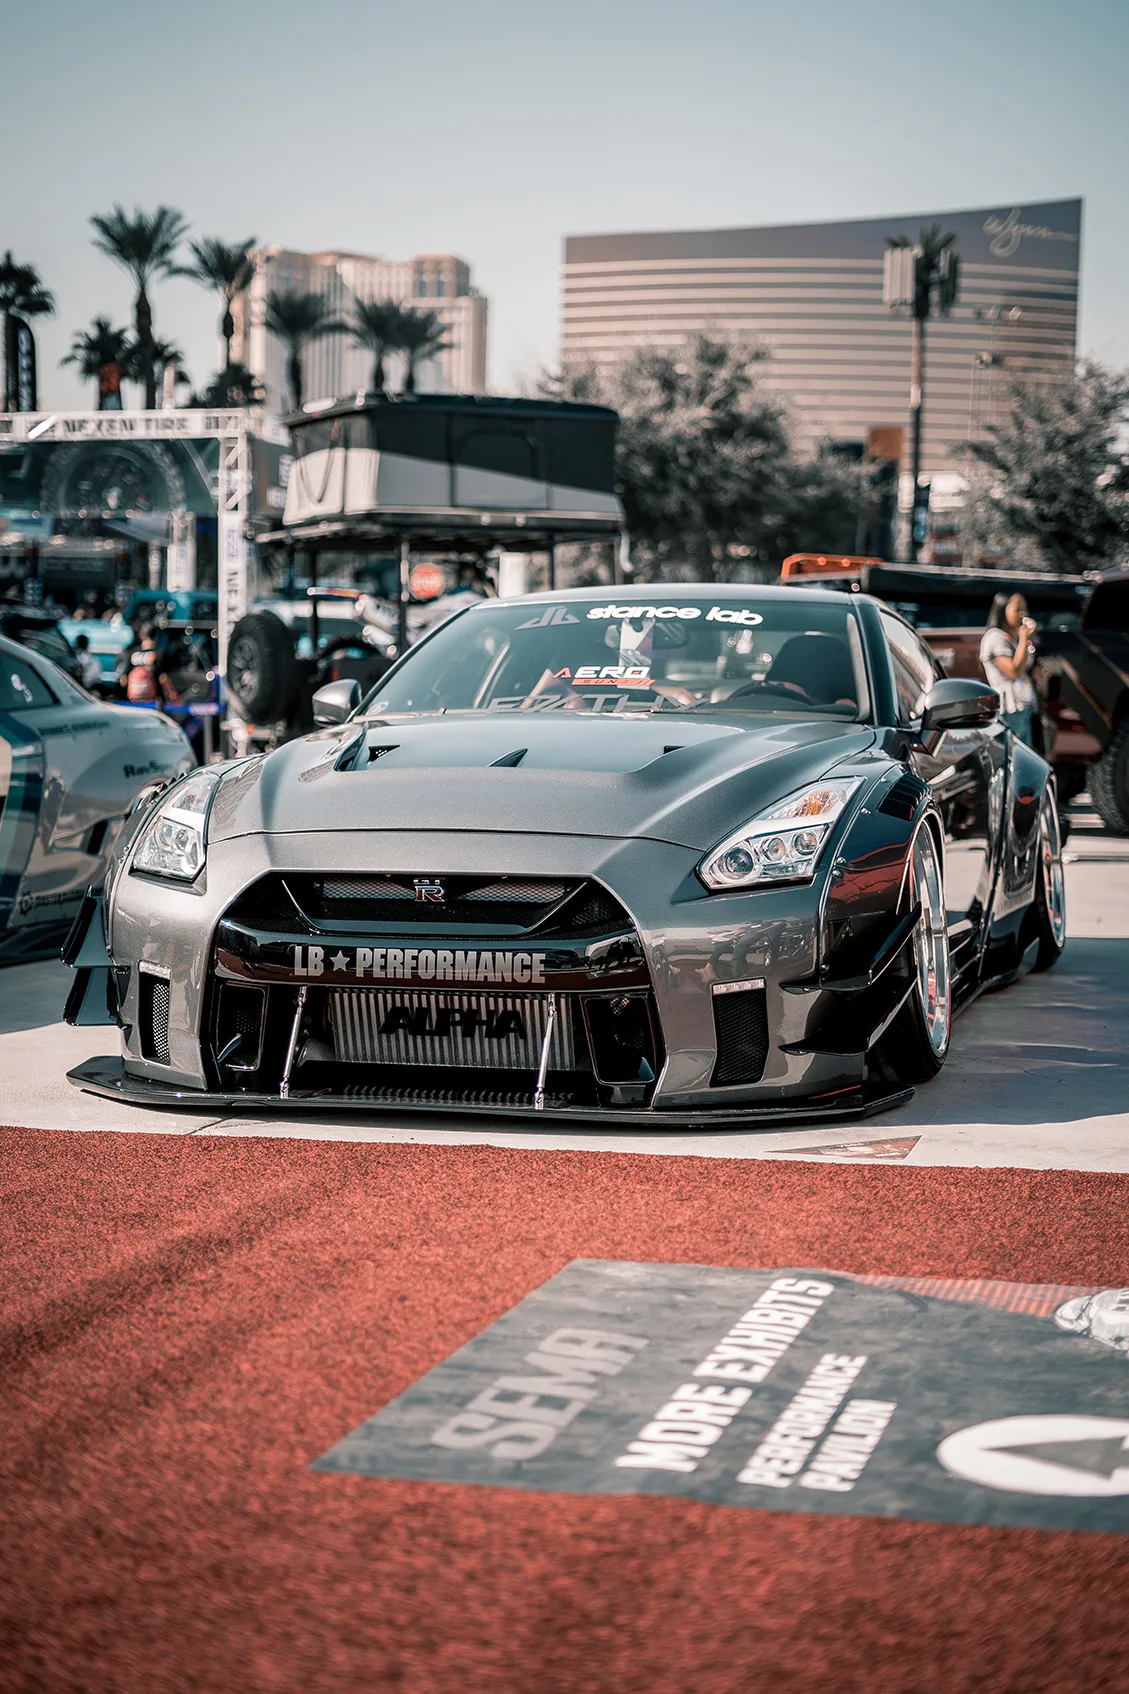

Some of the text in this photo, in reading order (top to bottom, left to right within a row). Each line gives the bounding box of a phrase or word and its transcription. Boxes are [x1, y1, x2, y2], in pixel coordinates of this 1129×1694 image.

[586, 604, 702, 620] stance
[705, 606, 764, 626] lab
[552, 666, 650, 679] AERO
[294, 946, 546, 984] LB PERFORMANCE
[378, 1006, 528, 1040] ALPHA
[430, 1327, 650, 1462] SEMA
[614, 1277, 836, 1473] MORE EXHIBITS
[737, 1352, 869, 1489] PERFORMANCE
[798, 1398, 898, 1493] PAVILION
